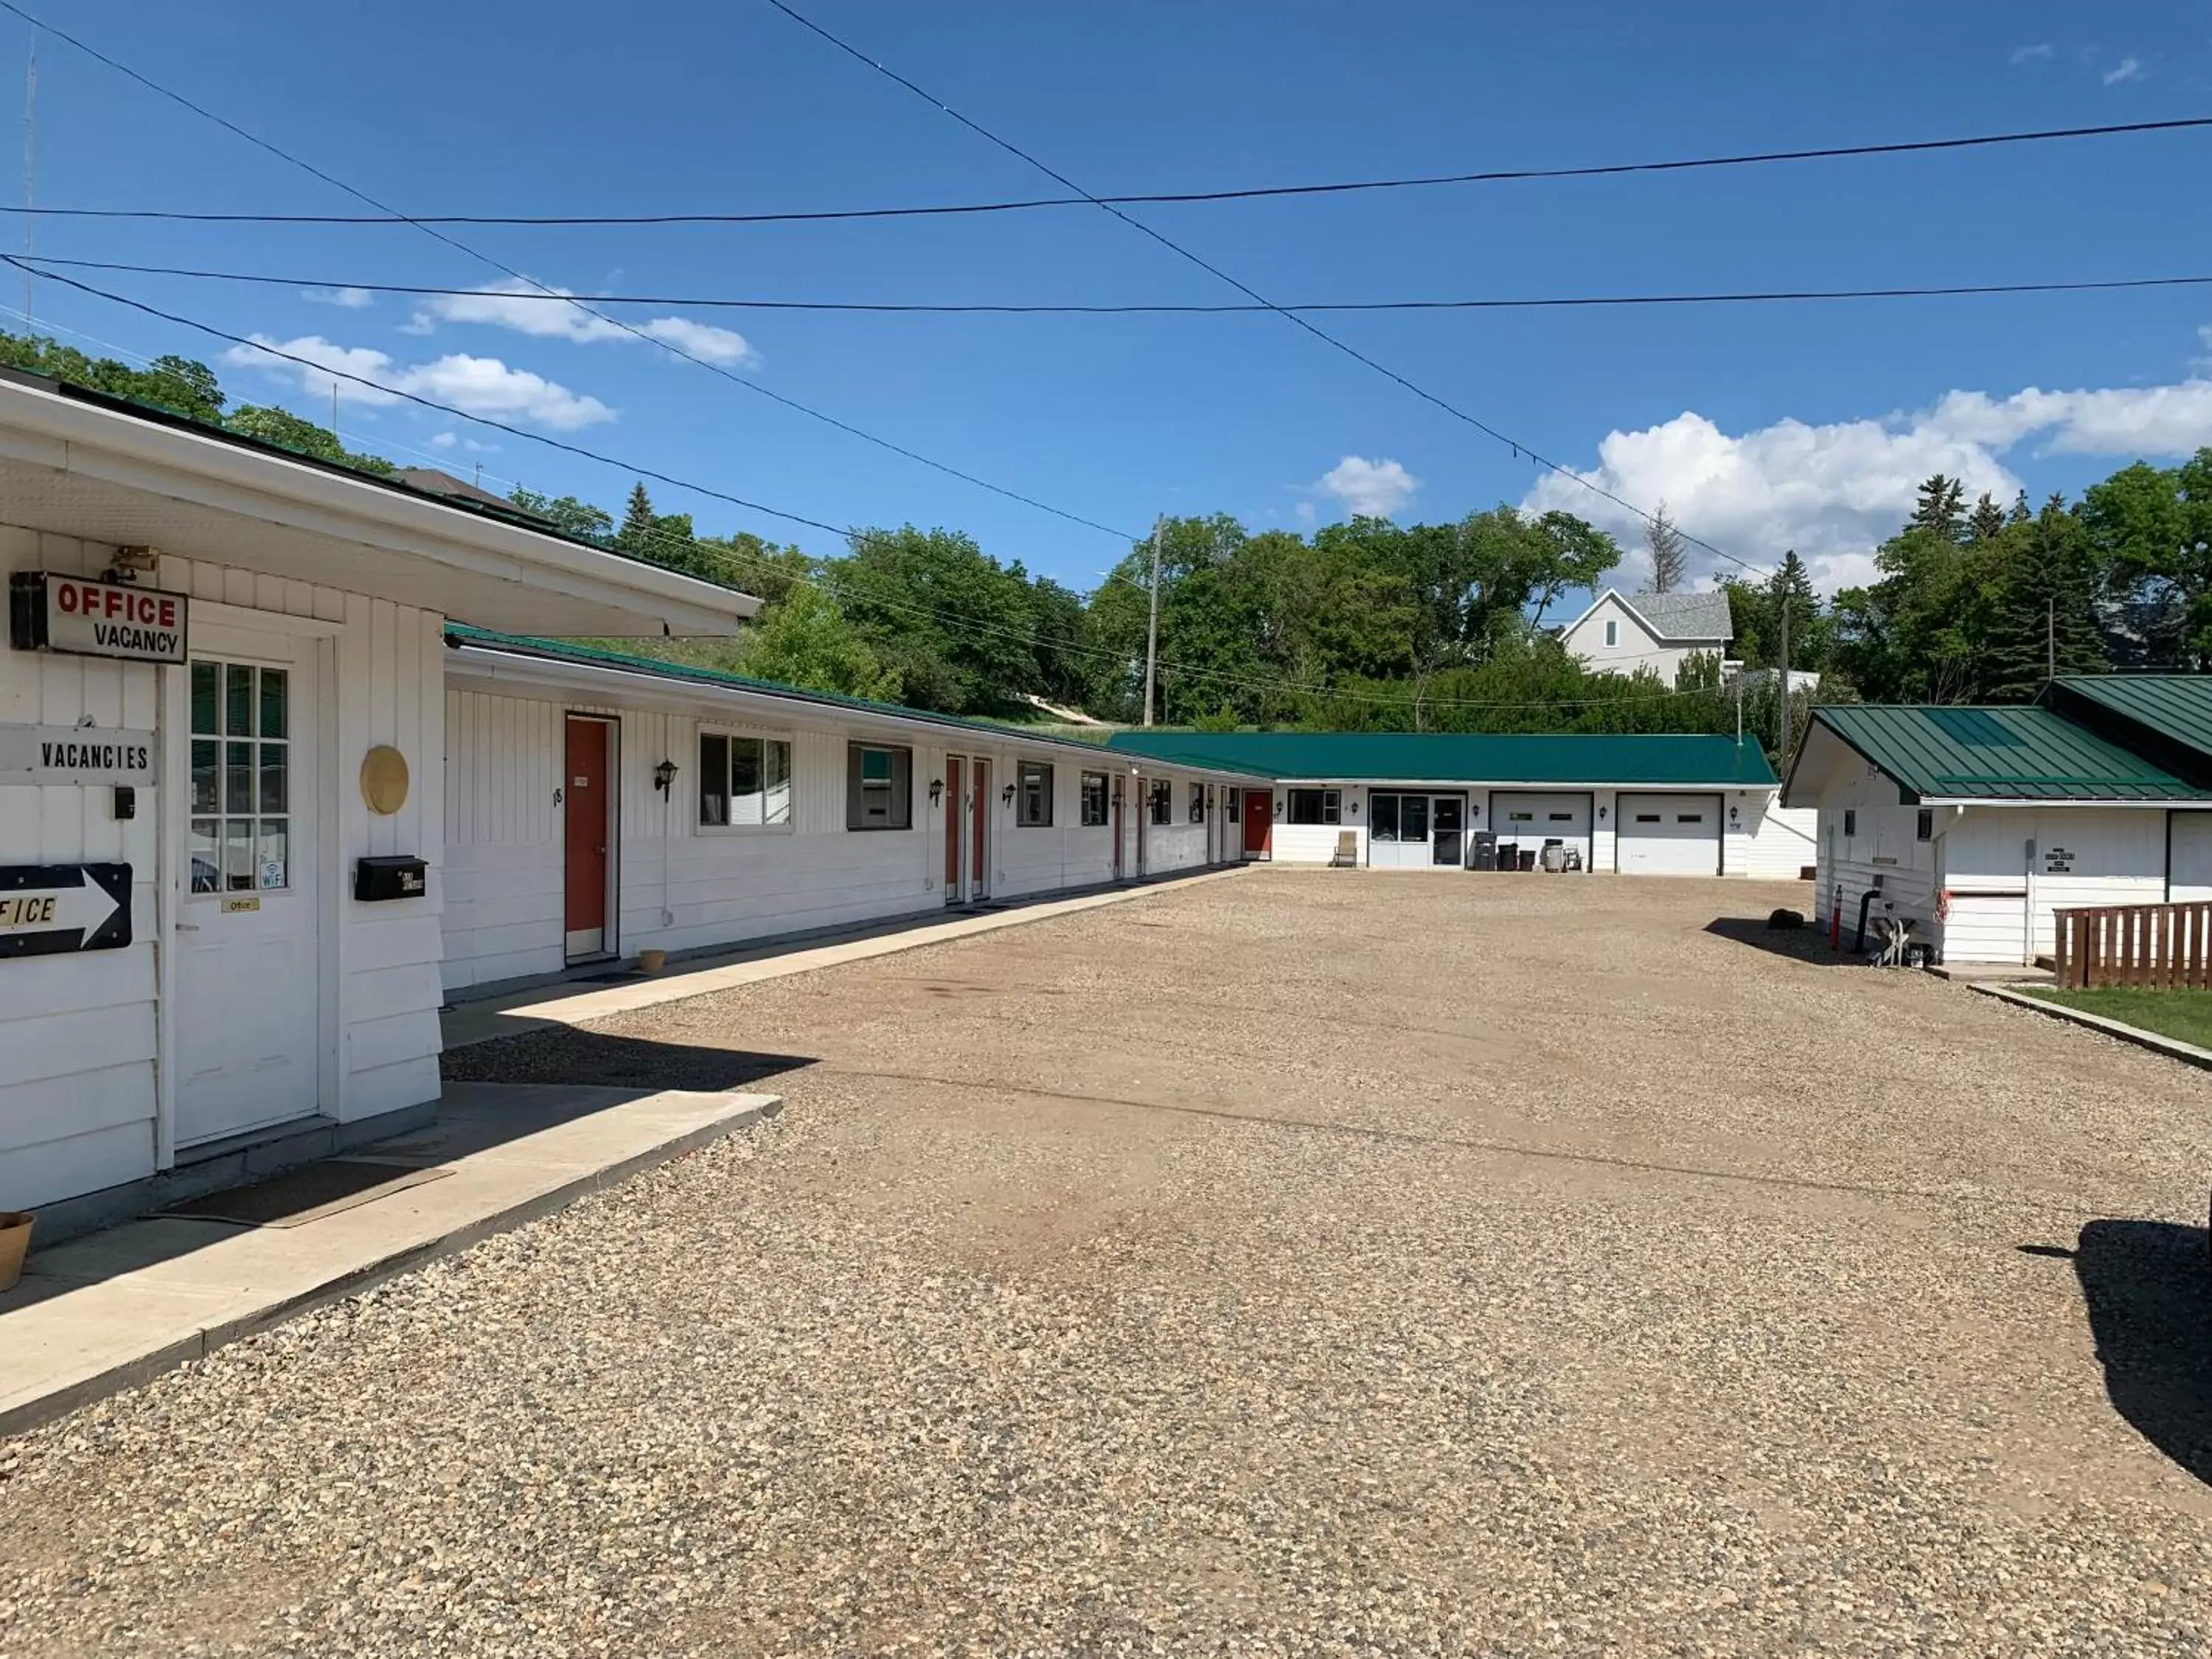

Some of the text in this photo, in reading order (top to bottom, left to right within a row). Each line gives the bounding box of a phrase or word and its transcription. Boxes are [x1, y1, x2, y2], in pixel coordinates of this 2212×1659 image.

[58, 583, 175, 627] OFFICE
[94, 623, 178, 654] VACANCY
[42, 742, 147, 769] VACANCIES
[0, 897, 55, 923] FICE
